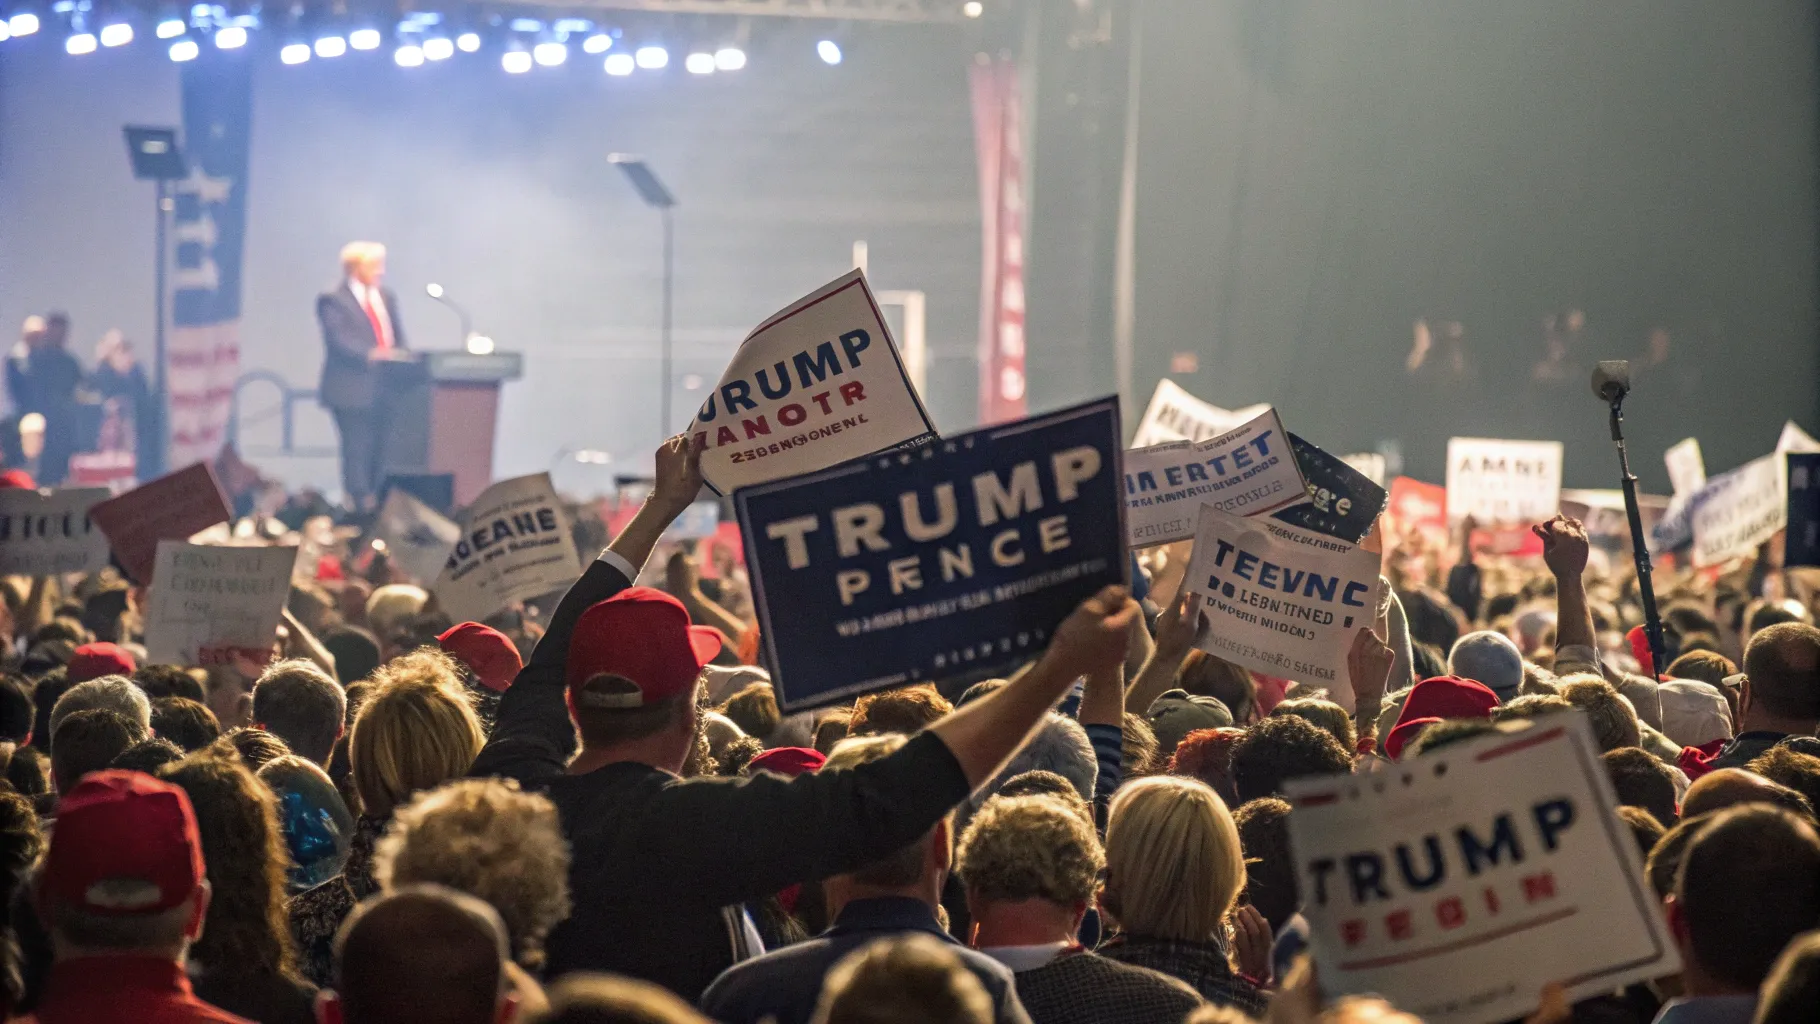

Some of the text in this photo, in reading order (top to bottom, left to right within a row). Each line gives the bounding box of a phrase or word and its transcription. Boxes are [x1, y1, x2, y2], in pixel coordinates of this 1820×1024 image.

[766, 445, 1102, 571] TRUMP
[836, 515, 1073, 607] PENCE
[1307, 796, 1578, 907] TRUMP
